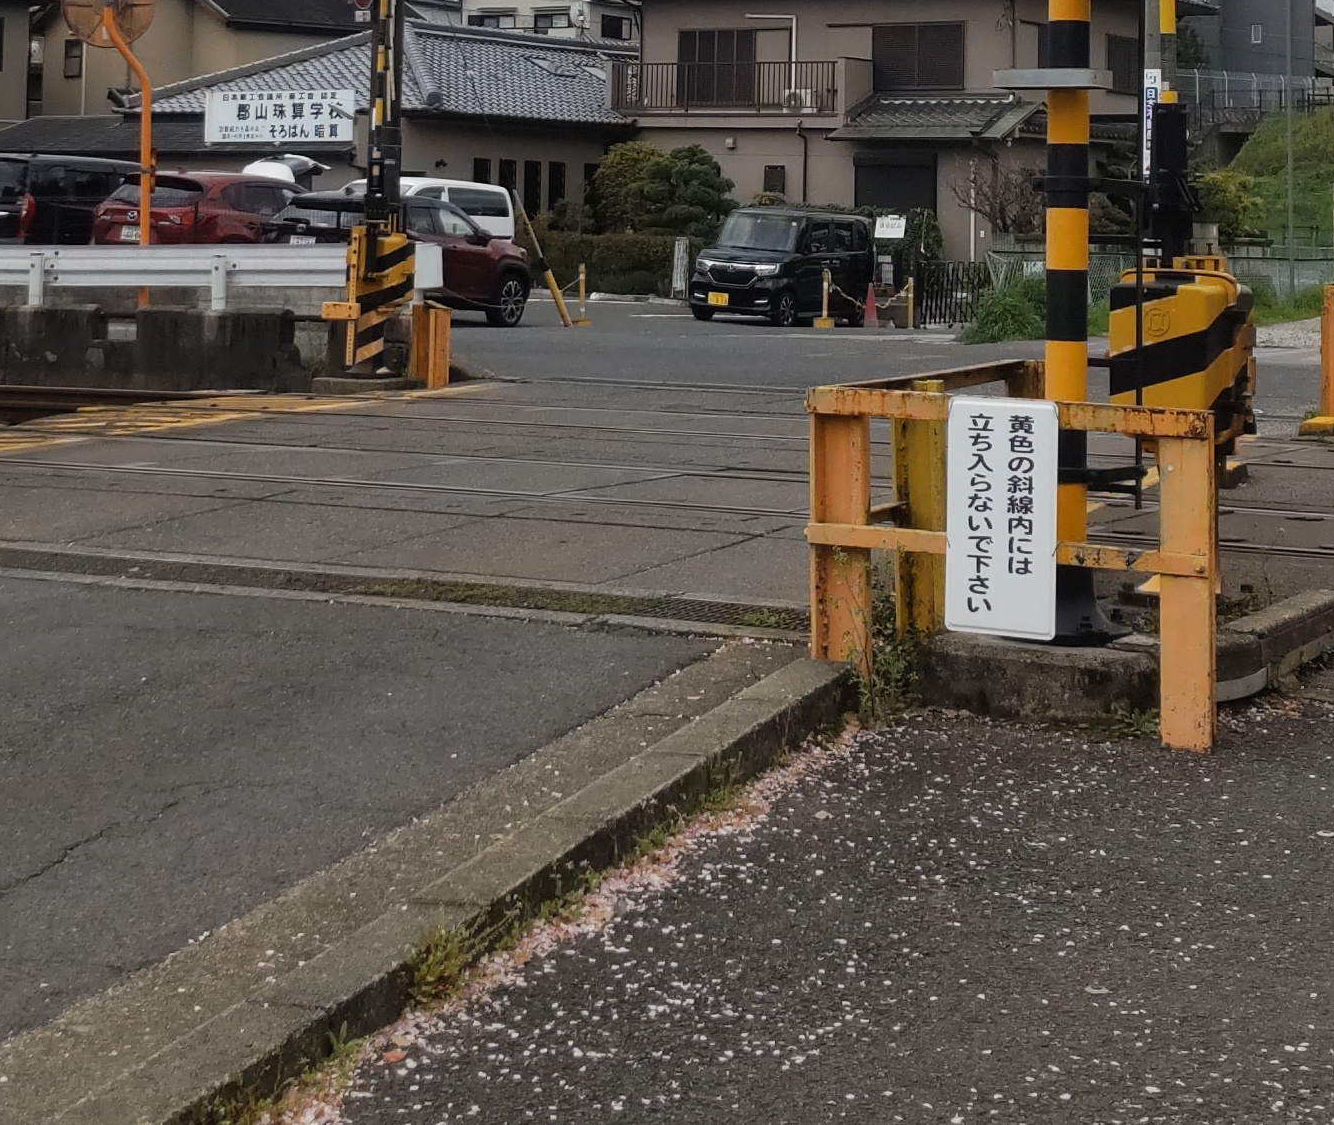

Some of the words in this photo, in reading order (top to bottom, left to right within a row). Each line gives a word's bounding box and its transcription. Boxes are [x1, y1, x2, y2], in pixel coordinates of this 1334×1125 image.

[237, 102, 344, 121] 郡山珠算学校
[269, 124, 309, 138] そろばん
[967, 413, 994, 613] 立ち入らないで下さい
[1006, 415, 1035, 575] 黄色の斜線内には
